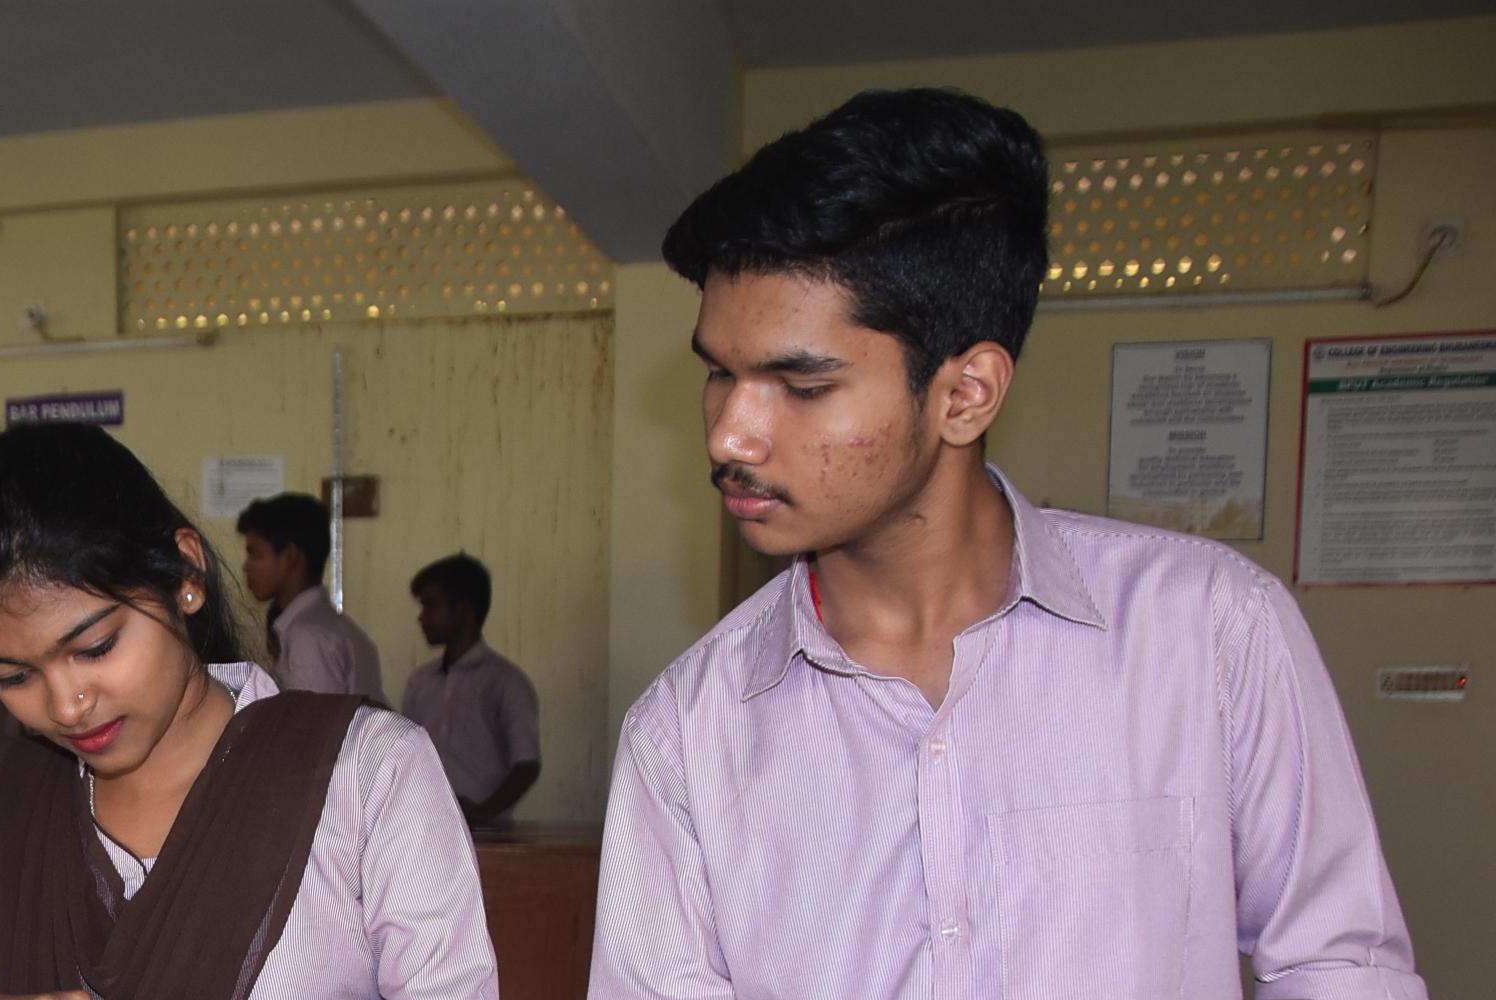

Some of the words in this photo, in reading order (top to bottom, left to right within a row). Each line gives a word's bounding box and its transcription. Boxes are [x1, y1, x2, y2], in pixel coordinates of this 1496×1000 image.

[1371, 376, 1425, 388] Academic
[1428, 374, 1489, 388] Regulation
[9, 404, 38, 421] BAR
[39, 400, 120, 418] PENDULUM
[1168, 430, 1207, 441] MISSION
